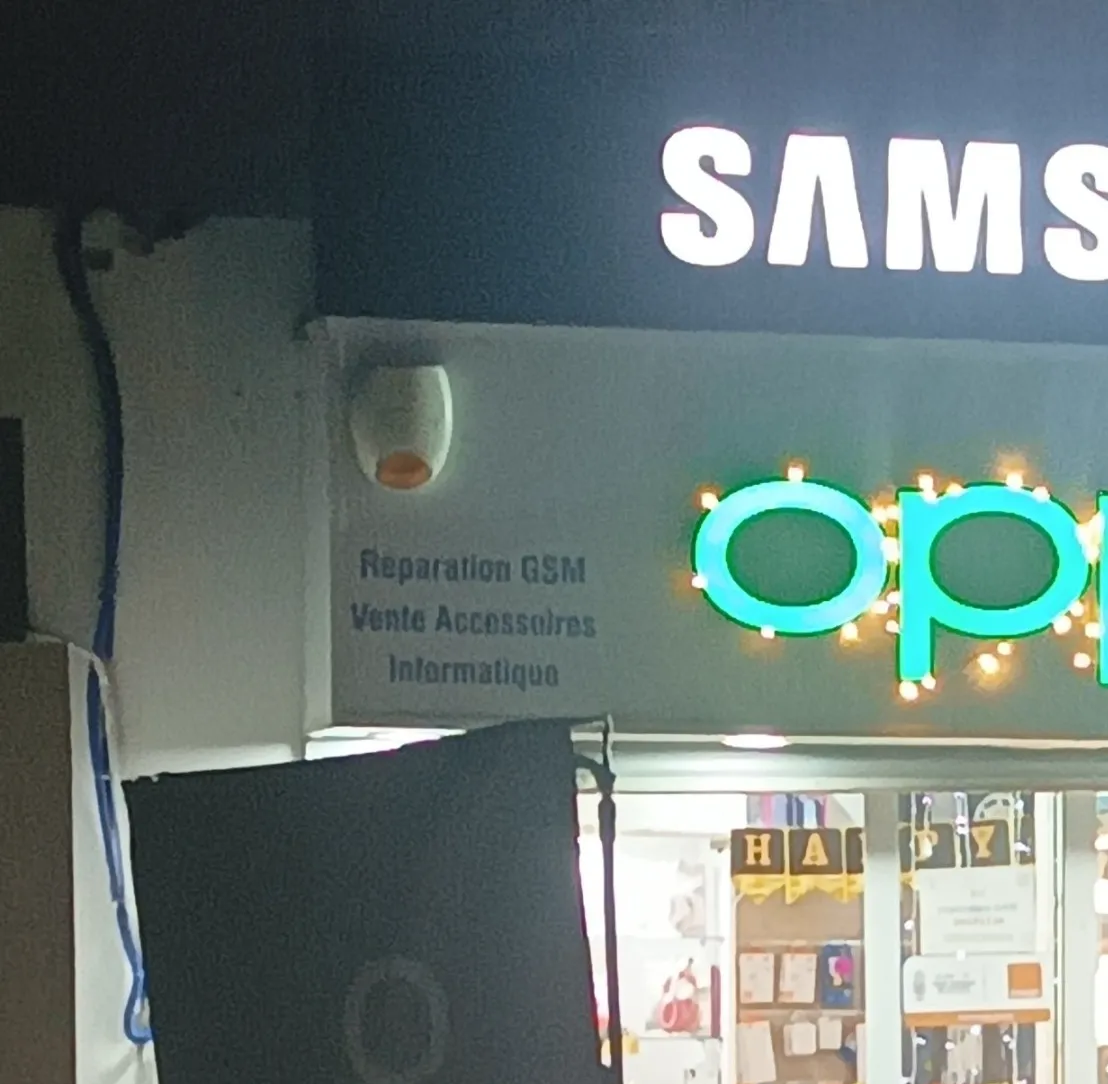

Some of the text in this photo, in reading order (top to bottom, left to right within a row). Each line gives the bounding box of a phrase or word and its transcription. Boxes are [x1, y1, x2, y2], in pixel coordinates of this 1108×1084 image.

[521, 555, 586, 584] GSM
[350, 602, 597, 638] Vente Accessoires
[389, 655, 560, 690] Informatique
